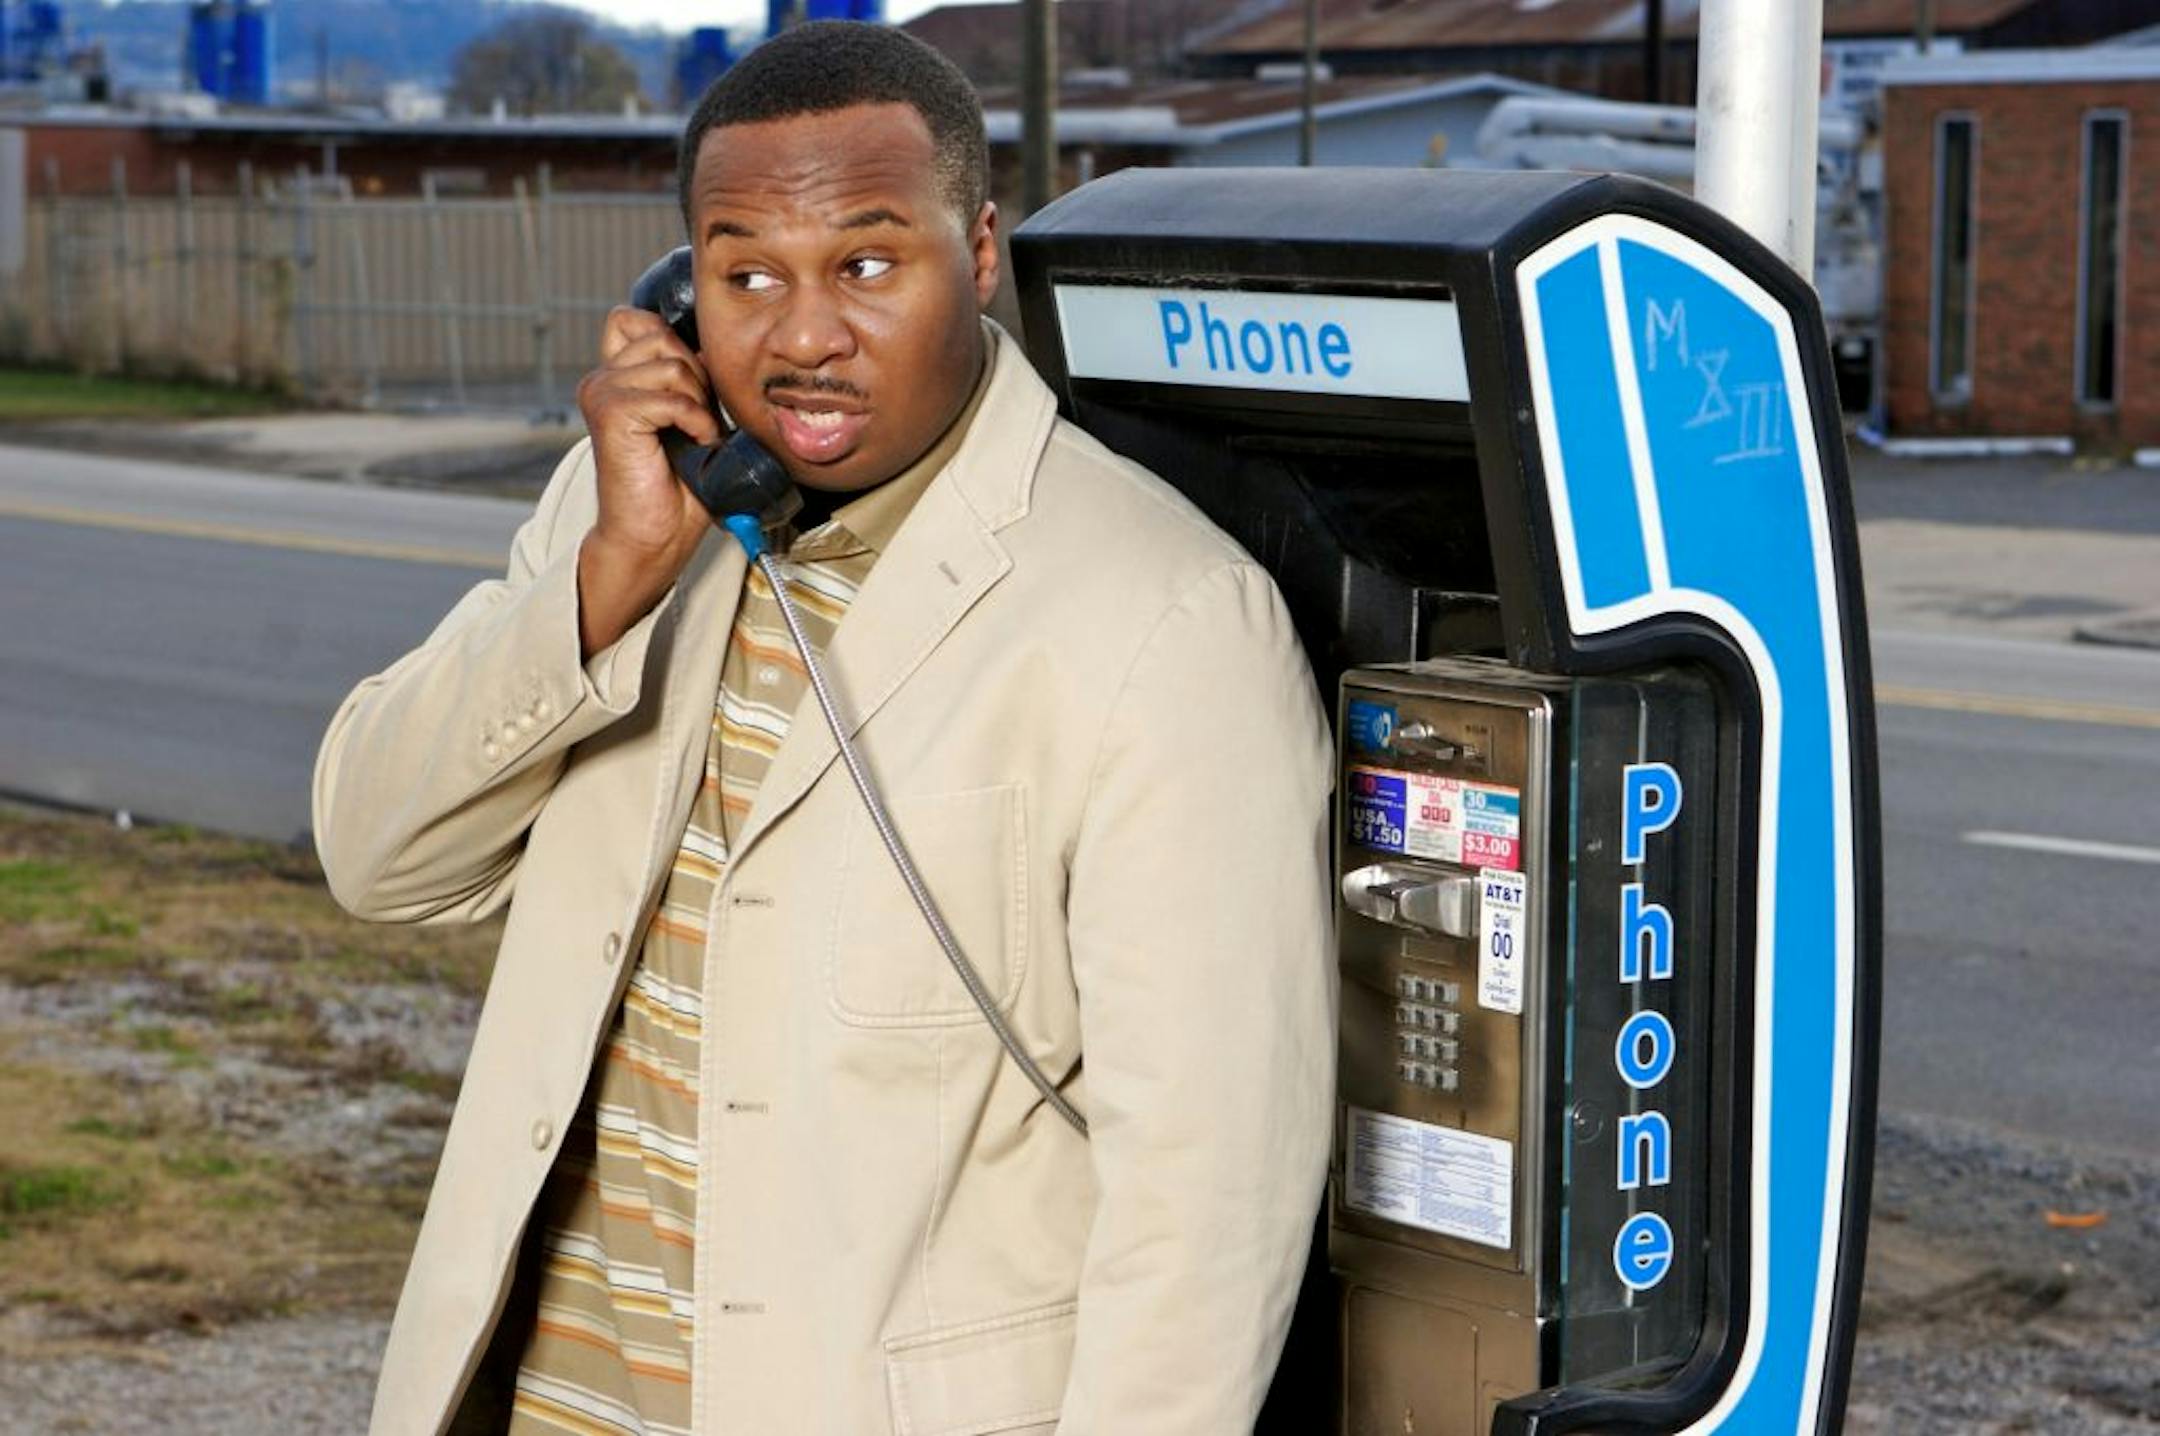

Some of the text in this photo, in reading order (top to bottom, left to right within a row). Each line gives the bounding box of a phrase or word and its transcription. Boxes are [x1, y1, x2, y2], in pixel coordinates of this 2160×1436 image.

[1159, 300, 1352, 377] Phone
[1353, 807, 1387, 826] USA
[1352, 823, 1402, 846] $1.50
[1465, 834, 1511, 857] $3.00
[1486, 884, 1522, 904] AT&T
[1491, 932, 1512, 959] 00
[1614, 761, 1682, 1290] Phone
